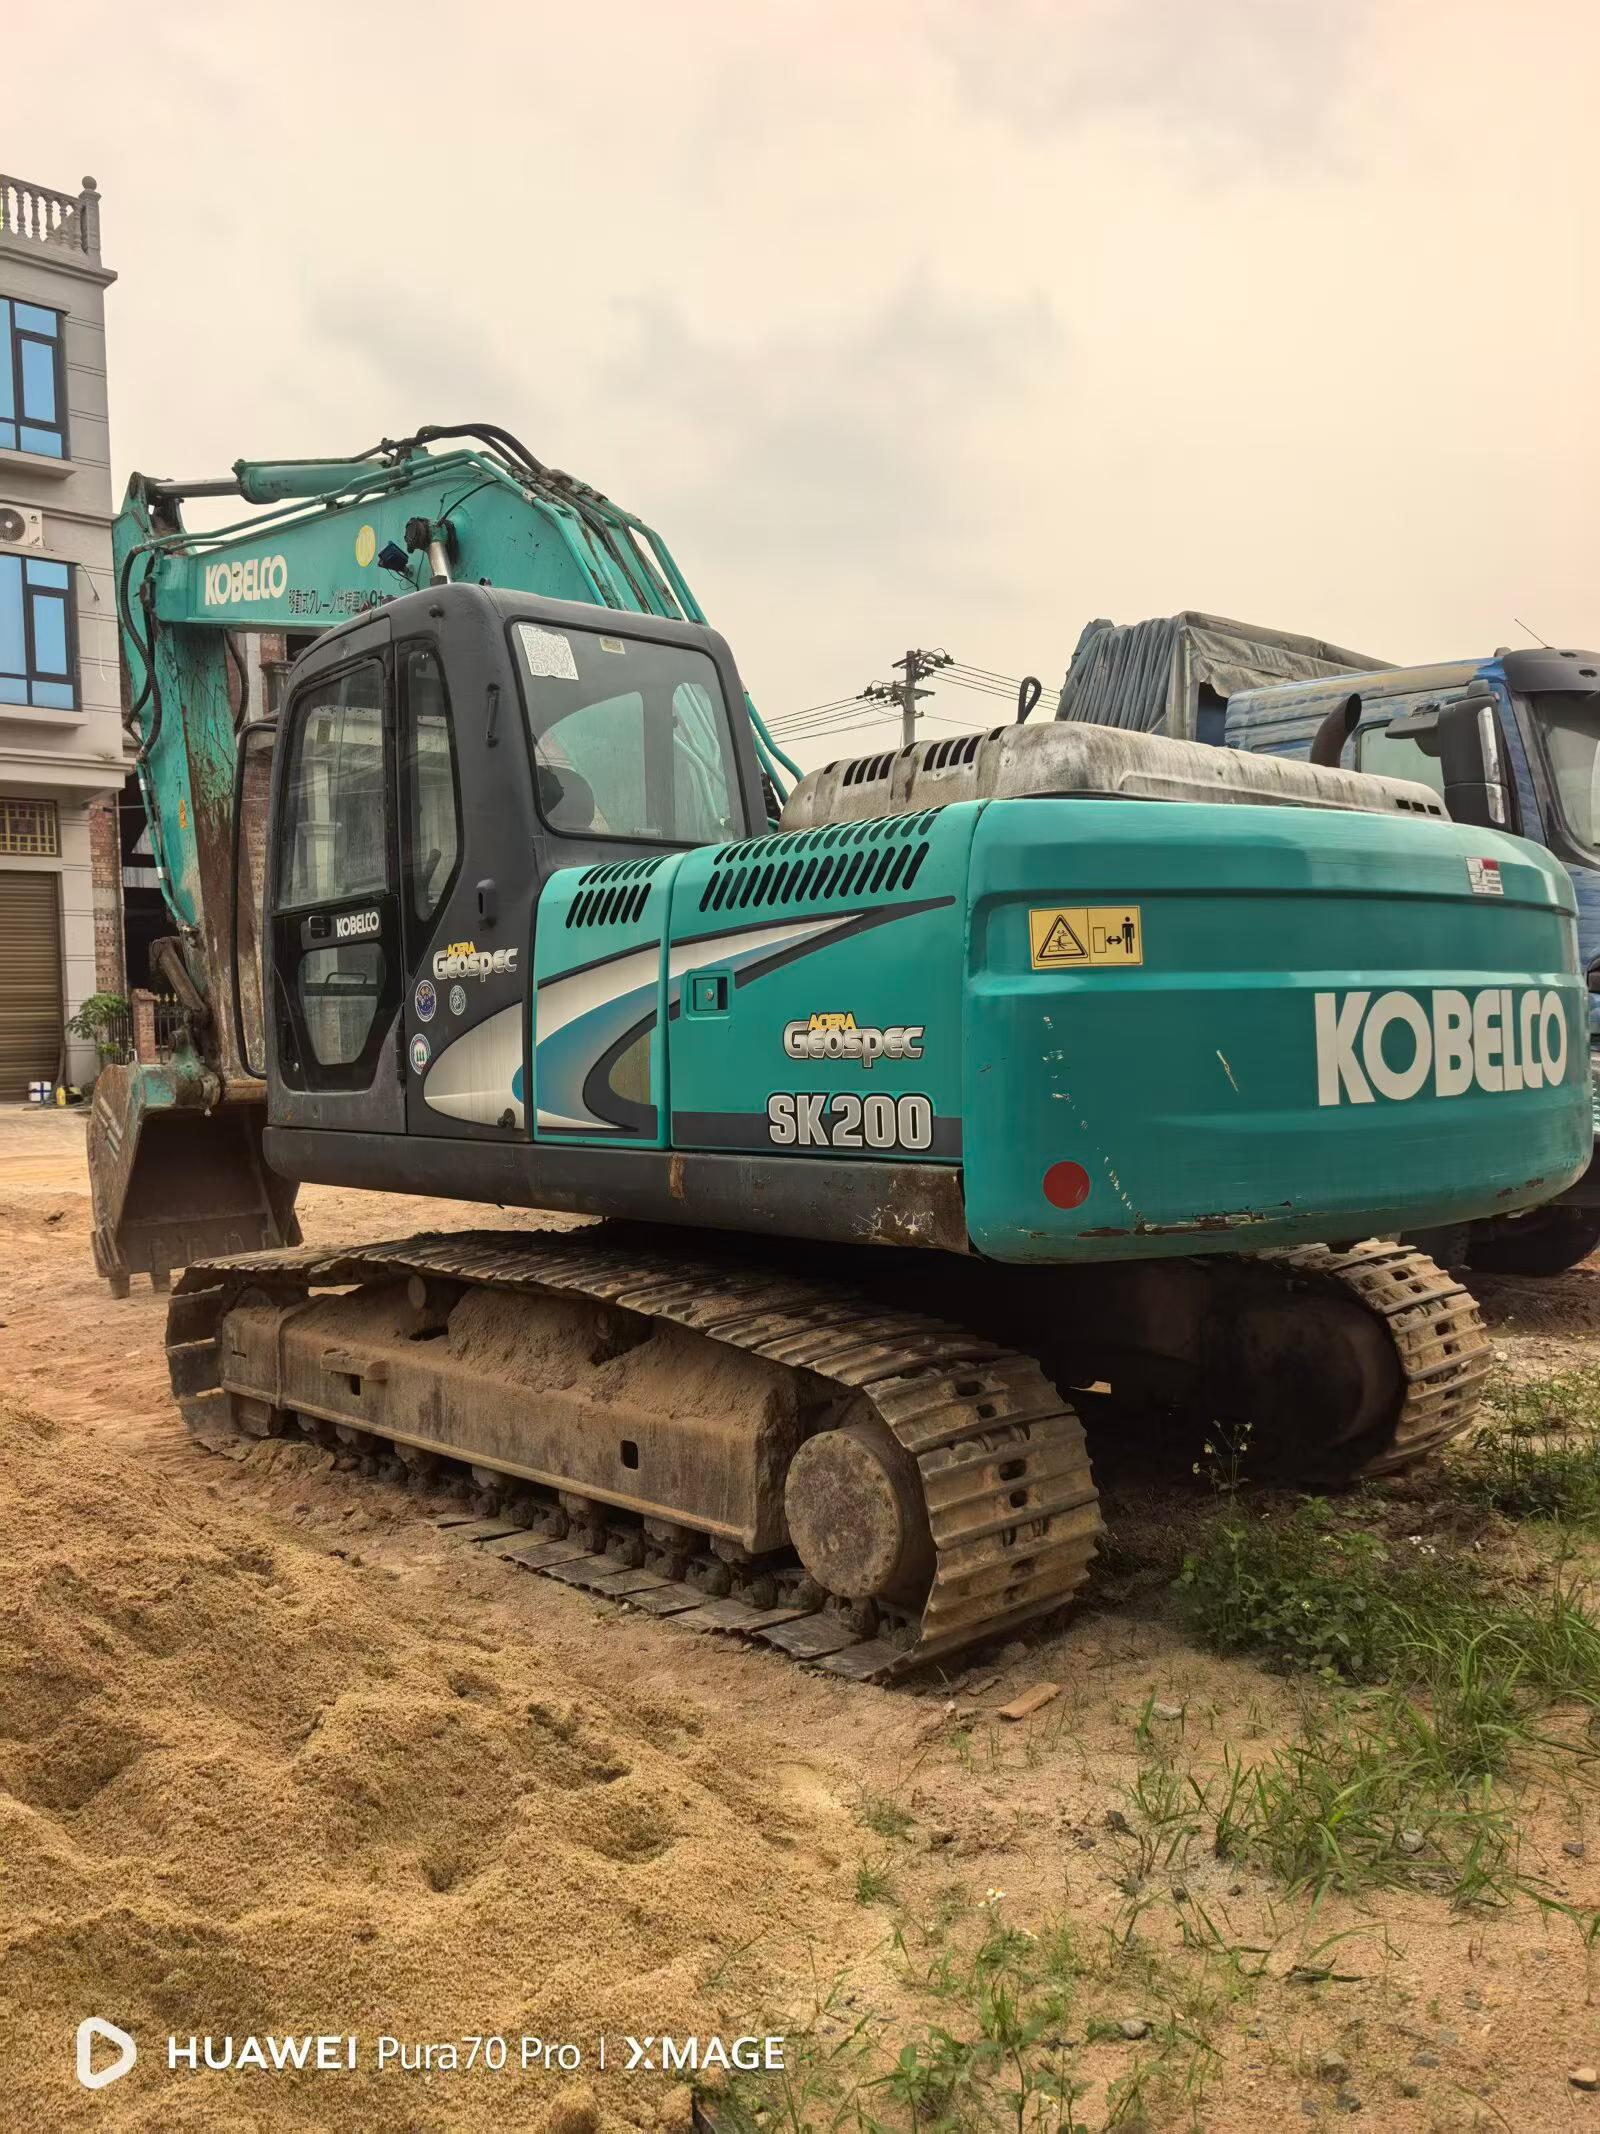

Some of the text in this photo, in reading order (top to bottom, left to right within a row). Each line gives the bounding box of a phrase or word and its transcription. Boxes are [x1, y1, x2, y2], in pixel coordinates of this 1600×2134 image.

[205, 555, 287, 605] KOBELCO
[336, 911, 380, 937] KOBELCO
[1314, 989, 1568, 1107] KOBELCO
[768, 1094, 933, 1150] SK200
